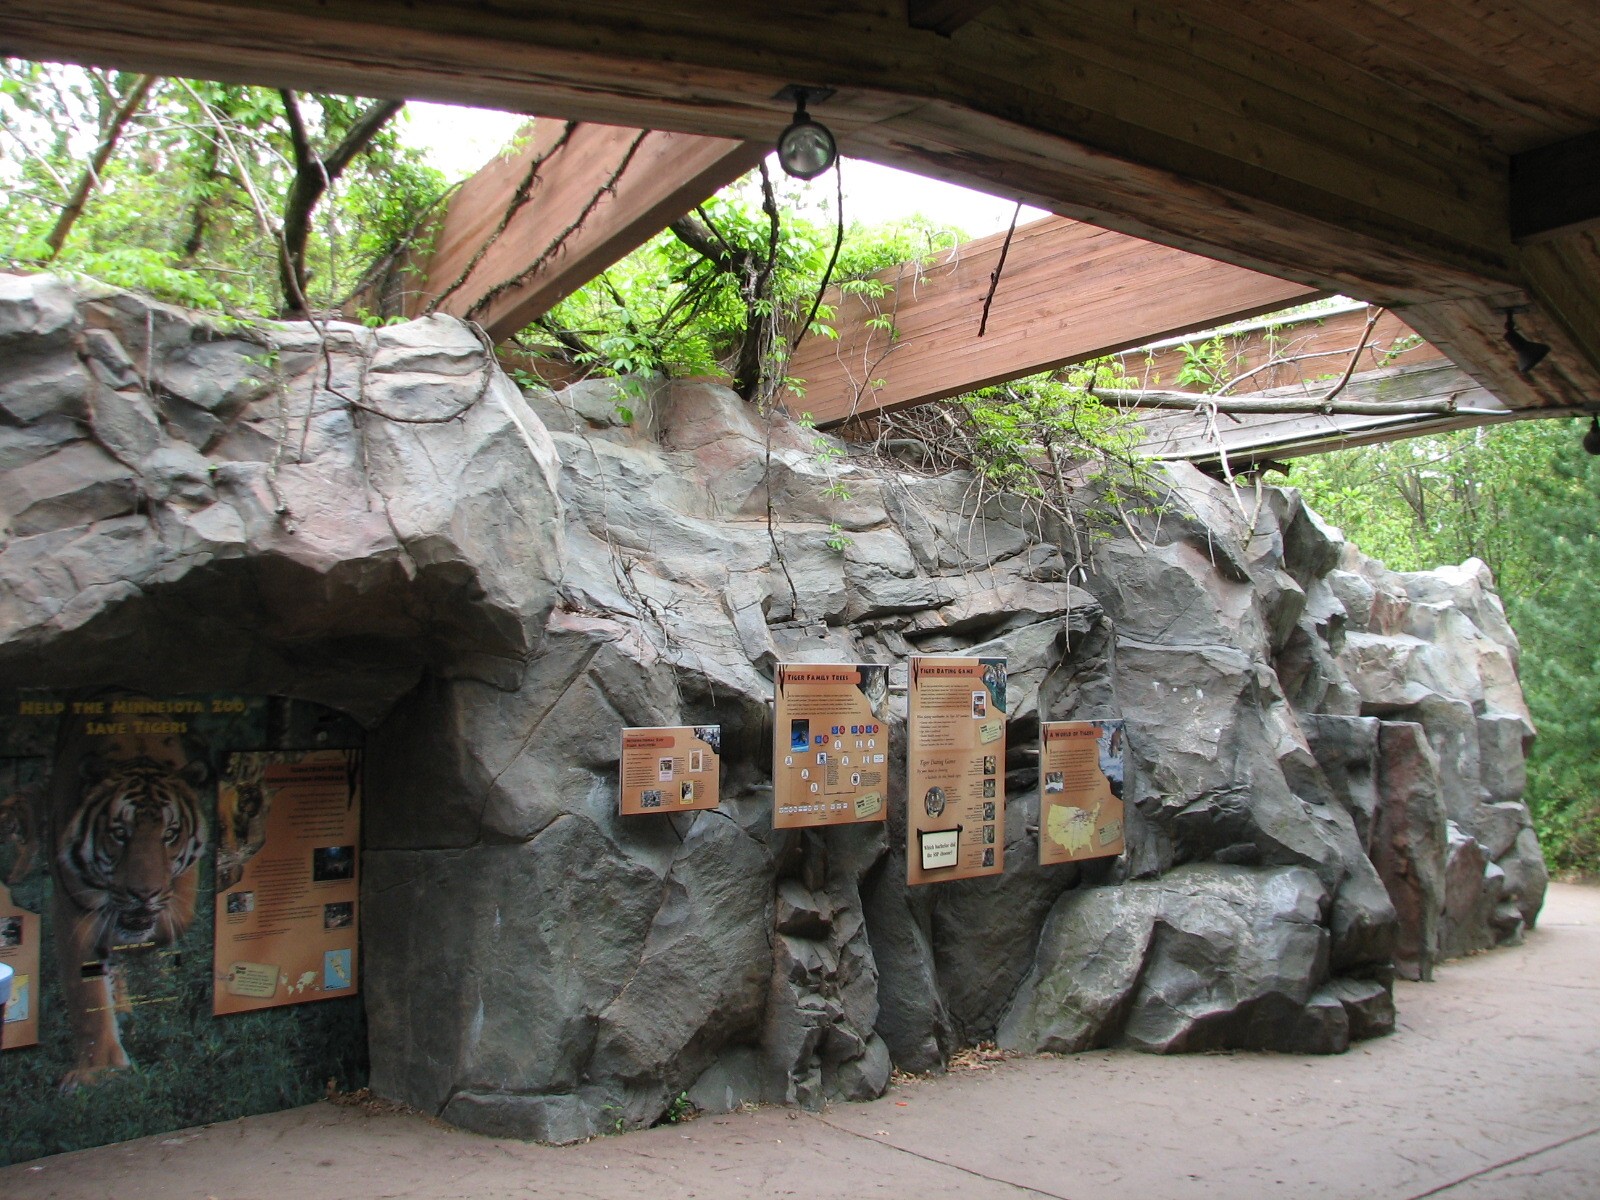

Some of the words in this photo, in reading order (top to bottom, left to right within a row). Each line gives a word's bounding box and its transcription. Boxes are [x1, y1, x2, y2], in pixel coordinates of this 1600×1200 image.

[20, 700, 65, 714] HELP
[73, 702, 104, 714] THE
[111, 700, 204, 714] MINNESOTA
[211, 699, 245, 713] ZOO
[86, 722, 127, 735] SAVE
[132, 720, 187, 734] TIGERS
